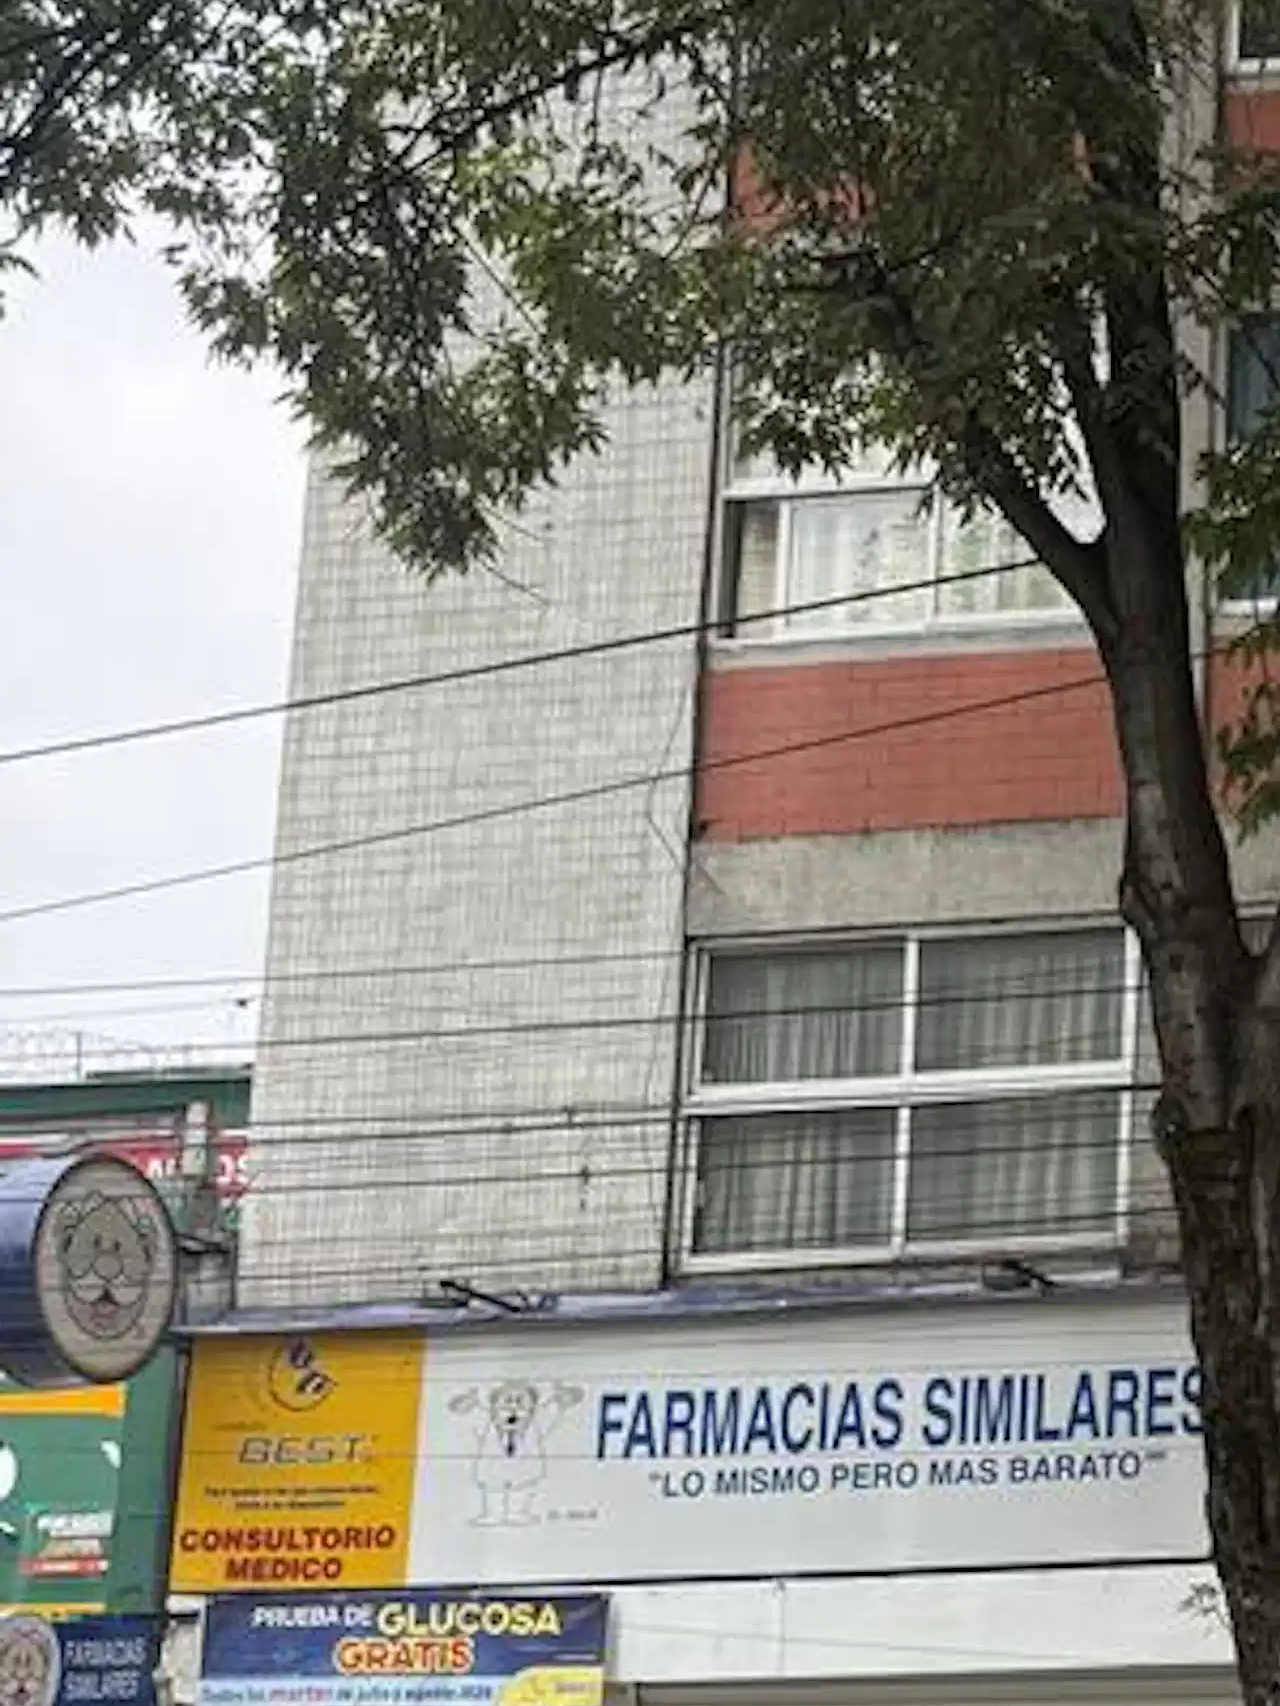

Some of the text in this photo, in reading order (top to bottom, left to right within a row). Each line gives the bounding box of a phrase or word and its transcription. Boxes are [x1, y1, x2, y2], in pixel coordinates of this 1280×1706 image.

[597, 1365, 1206, 1460] FARMACIAS SIMILARES
[715, 1464, 820, 1495] MISMO
[831, 1460, 918, 1490] PERO
[929, 1458, 998, 1486] MAS
[180, 1525, 397, 1552] CONSULTORIO
[224, 1557, 343, 1582] MEDICO
[251, 1602, 563, 1636] PRUEBA DE GLUCOSA
[335, 1638, 475, 1673] GRATIS
